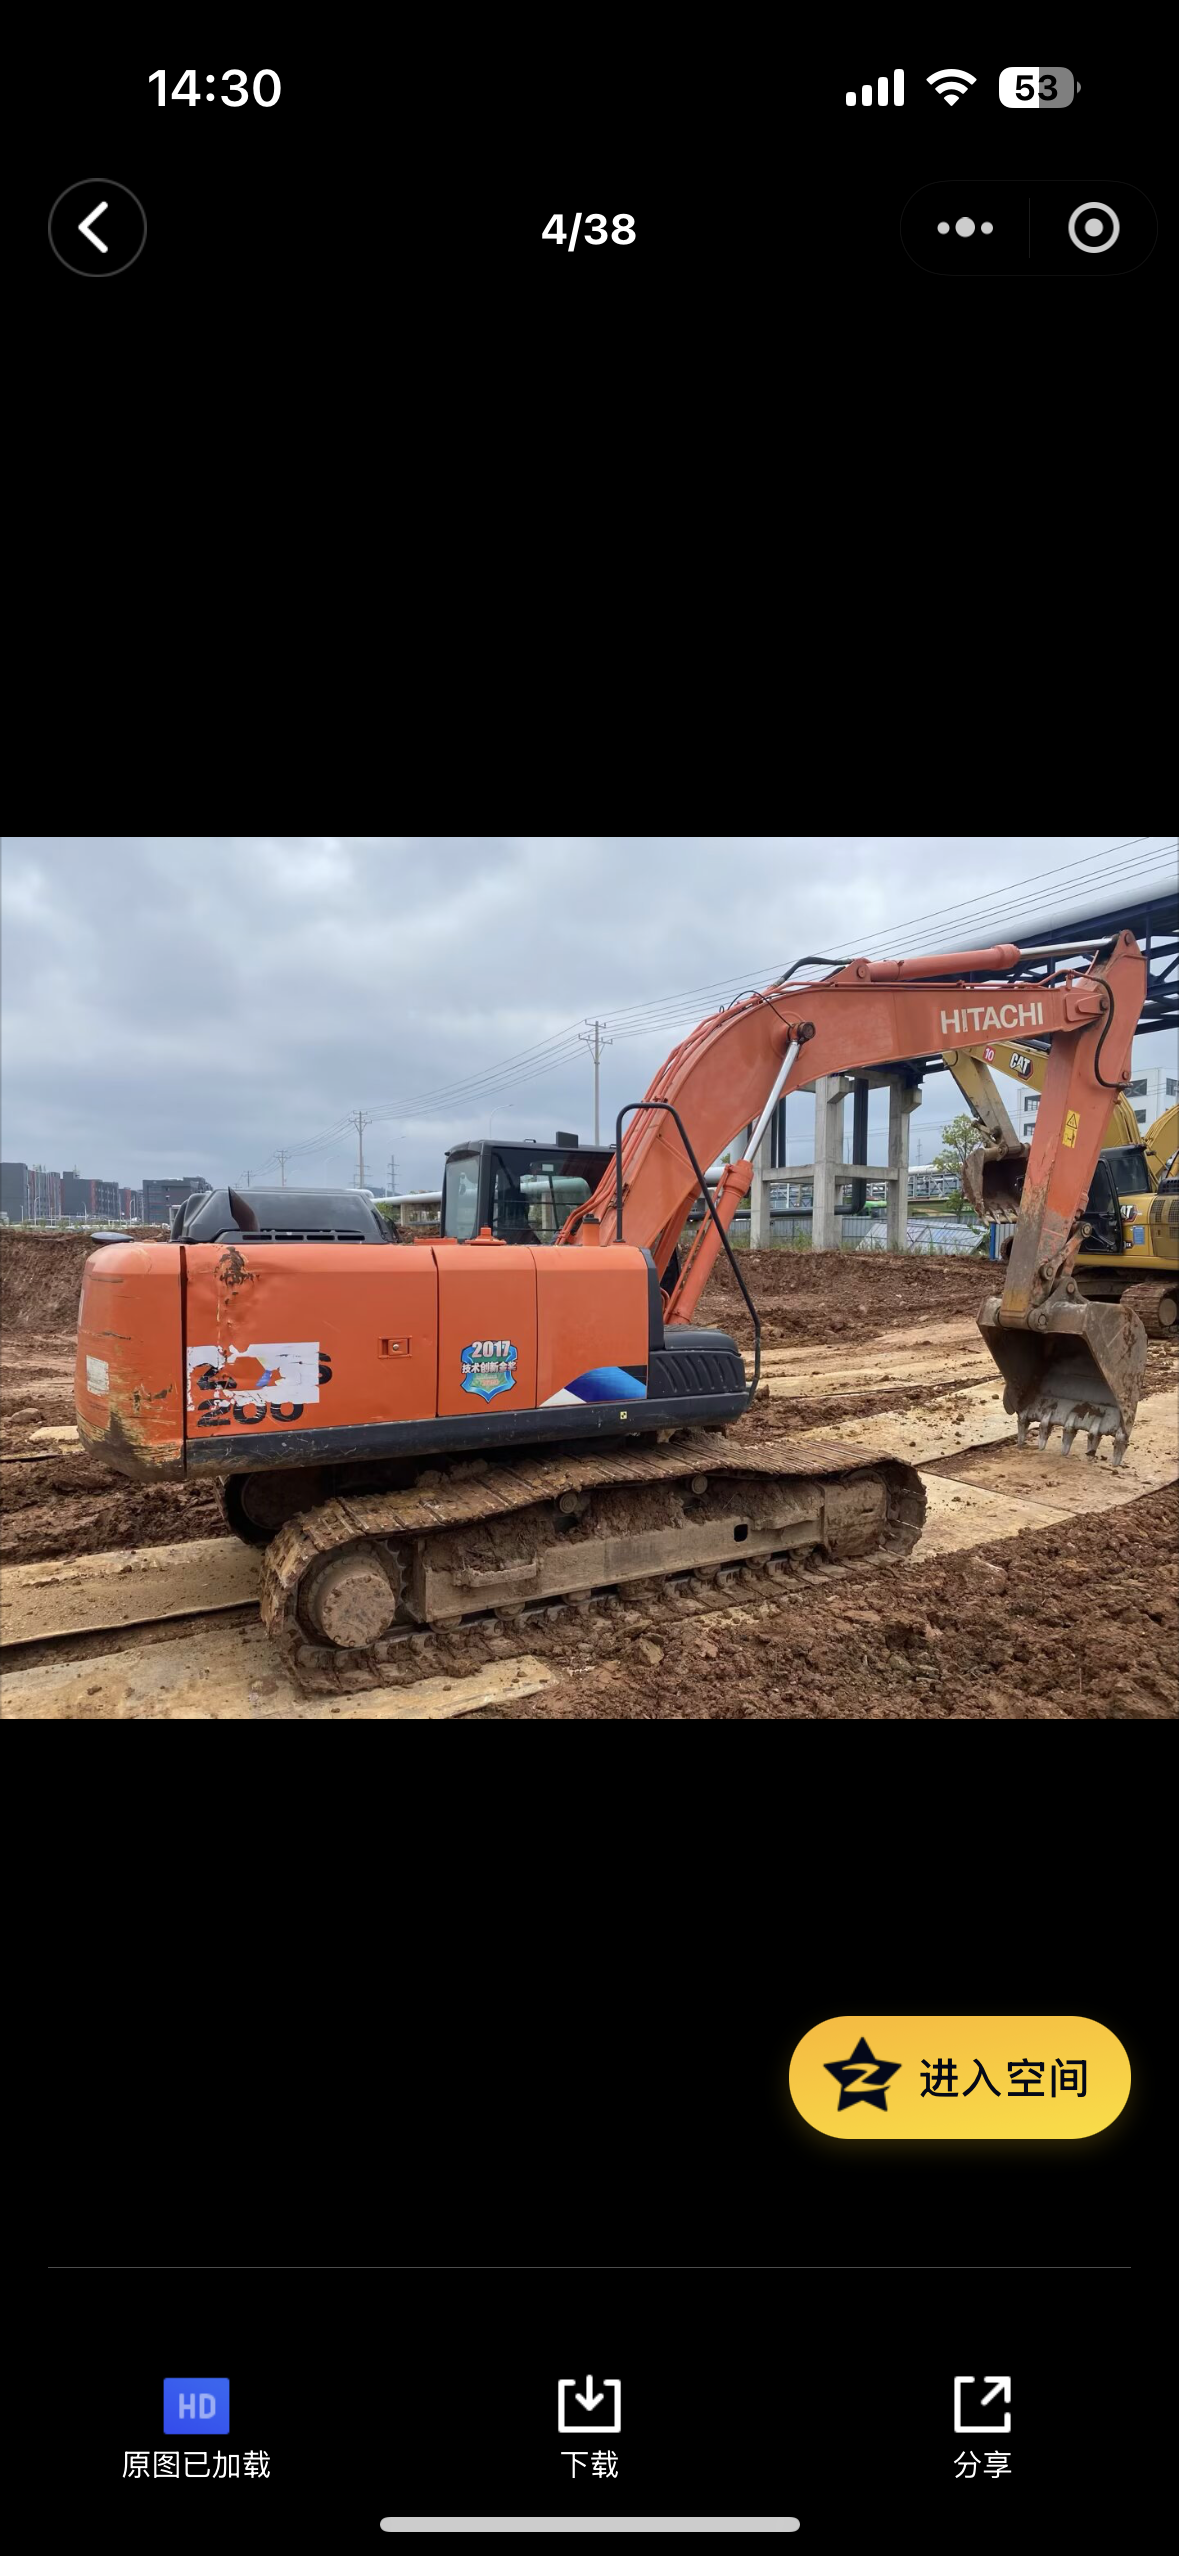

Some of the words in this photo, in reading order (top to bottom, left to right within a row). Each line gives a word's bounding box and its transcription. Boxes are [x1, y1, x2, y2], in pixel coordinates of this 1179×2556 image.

[940, 1002, 1044, 1034] HITACHI
[985, 1047, 995, 1062] 10
[1010, 1052, 1030, 1075] CAT
[471, 1340, 511, 1358] 2017
[462, 1361, 517, 1374] 技术创新金奖
[197, 1398, 304, 1427] 200
